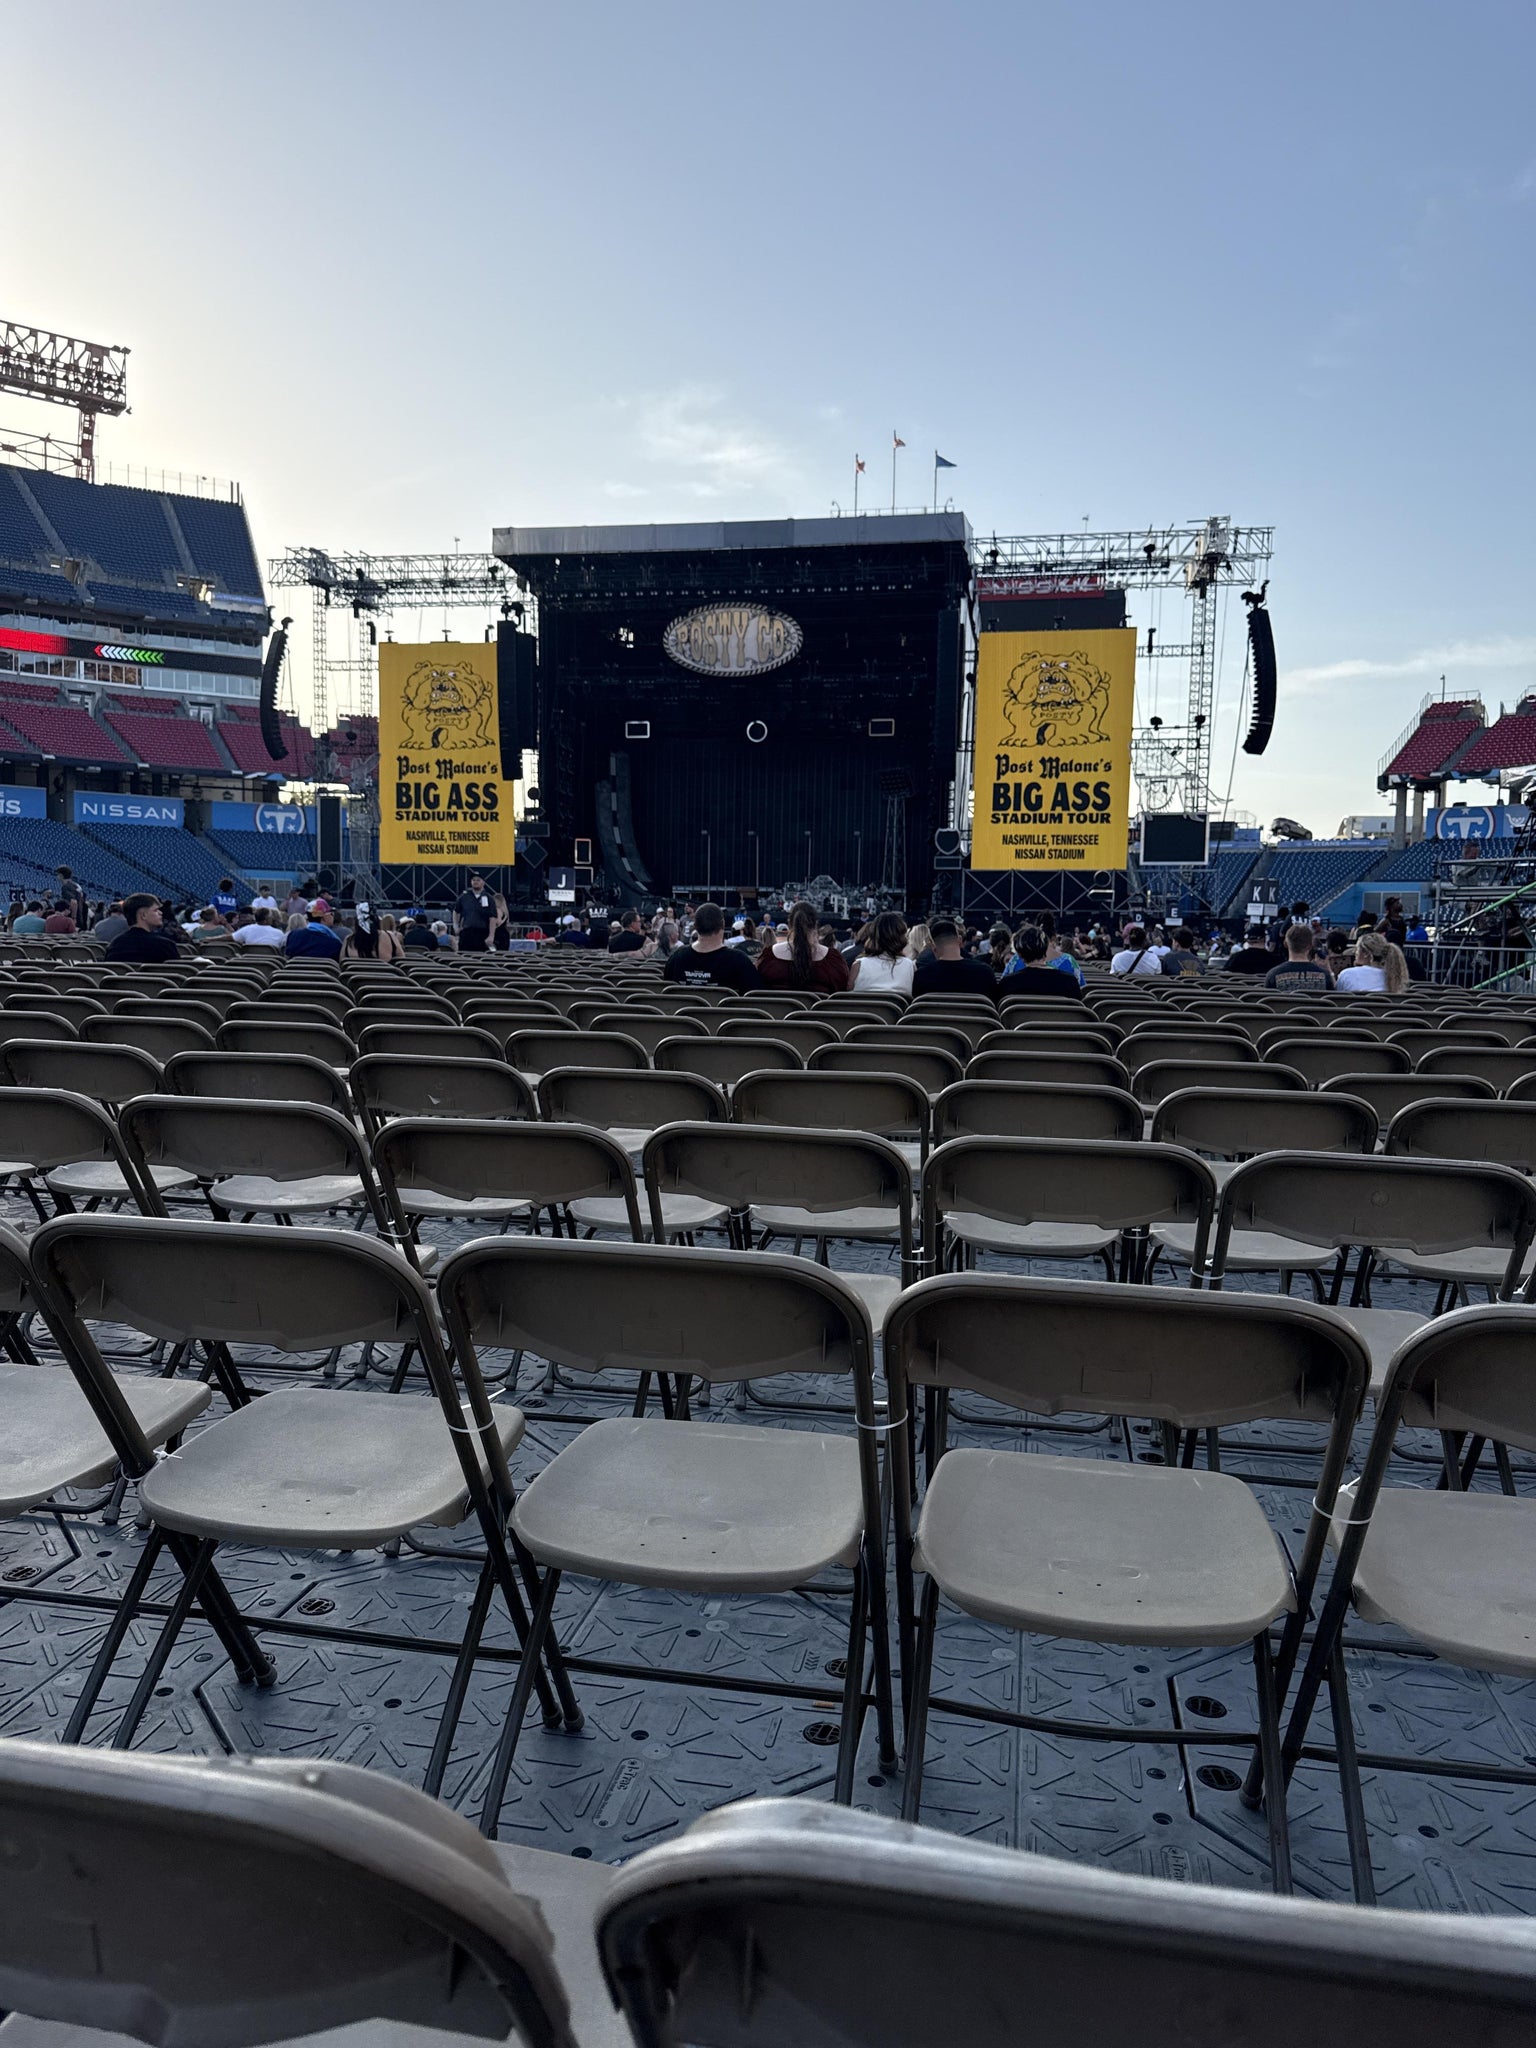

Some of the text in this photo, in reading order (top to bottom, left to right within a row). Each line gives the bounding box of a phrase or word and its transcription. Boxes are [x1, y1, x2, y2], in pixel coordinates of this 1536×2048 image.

[676, 611, 784, 668] POSTY CO
[1039, 711, 1074, 719] POSTY
[396, 756, 498, 780] Post Malone's
[995, 753, 1112, 781] Post Malone's
[396, 782, 499, 811] BIG ASS
[992, 781, 1111, 812] BIG ASS
[82, 802, 177, 821] NISSAN
[395, 811, 500, 822] STADIUM TOUR
[990, 812, 1111, 824] STADIUM TOUR
[406, 830, 490, 843] NASHVILLE, TENNESSEE
[1002, 834, 1099, 847] NASHVILLE, TENNESSEE
[417, 844, 479, 855] NISSAN STADIUM
[1014, 849, 1085, 860] NISSAN STADIUM
[557, 873, 566, 888] J
[1252, 886, 1262, 902] K
[1268, 886, 1276, 903] K
[1135, 913, 1142, 922] D
[1170, 907, 1179, 918] E
